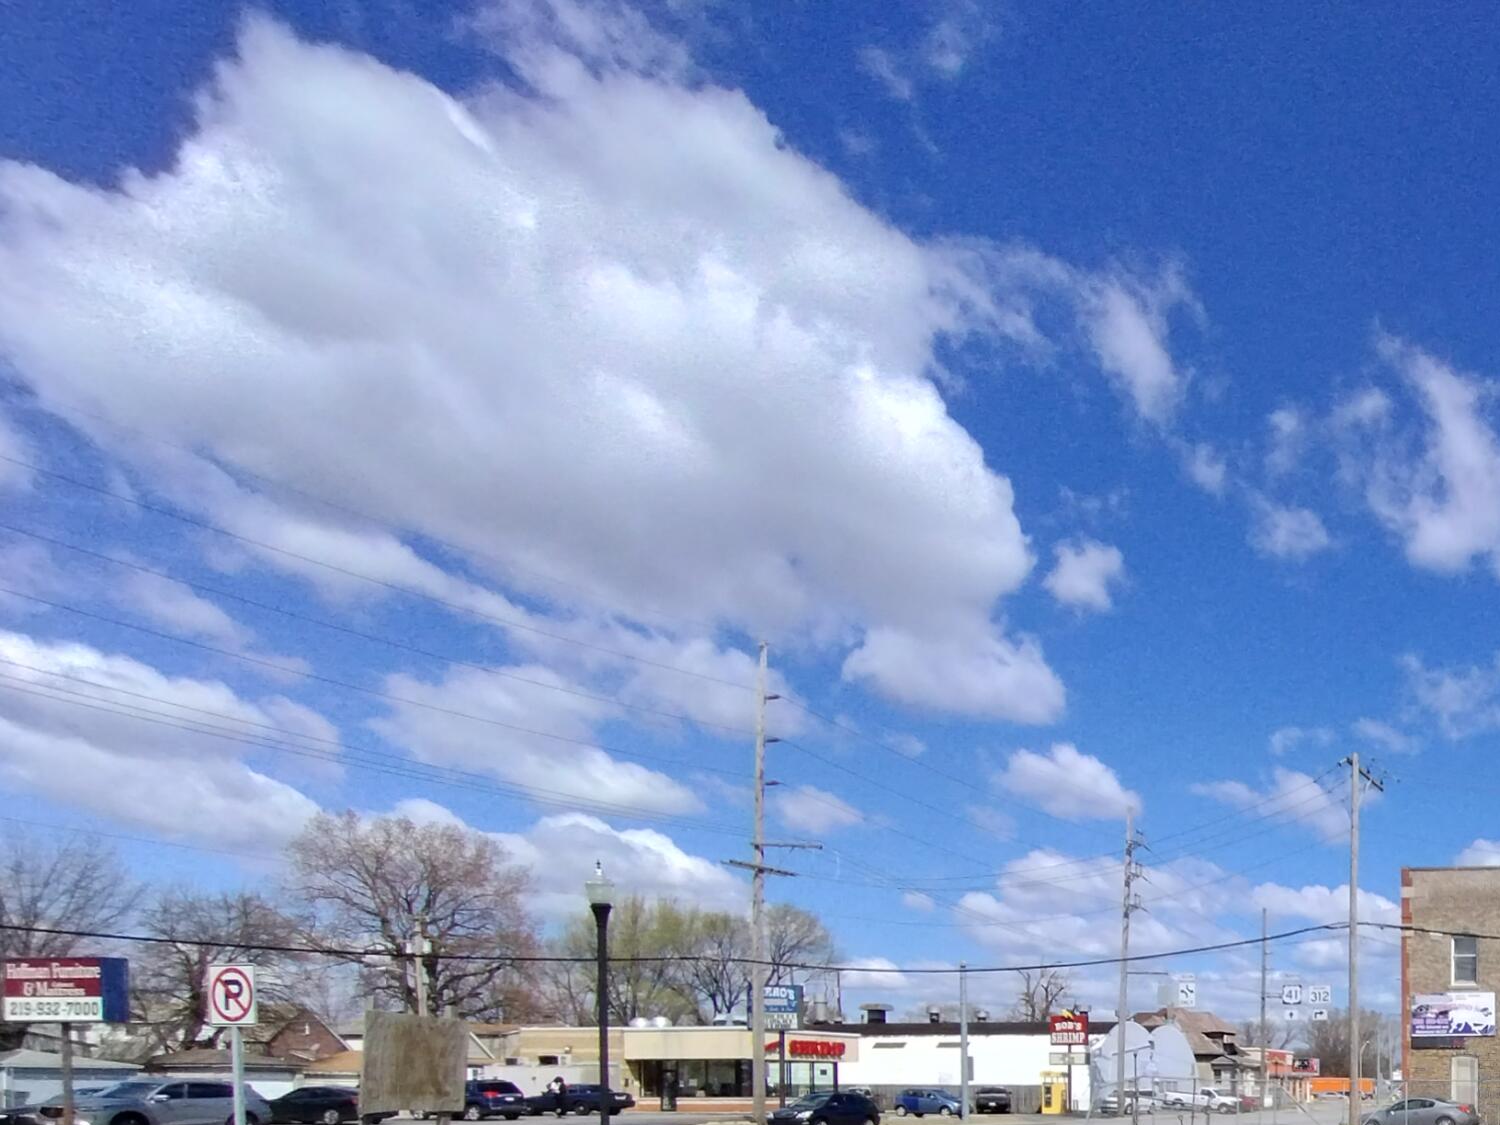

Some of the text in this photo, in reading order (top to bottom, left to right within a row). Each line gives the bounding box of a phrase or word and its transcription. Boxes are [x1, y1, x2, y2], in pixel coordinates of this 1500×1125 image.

[1285, 990, 1298, 1001] 41
[1310, 991, 1330, 1002] 312
[10, 1001, 99, 1016] 219-932-7000
[1052, 1032, 1085, 1044] SHRIMP
